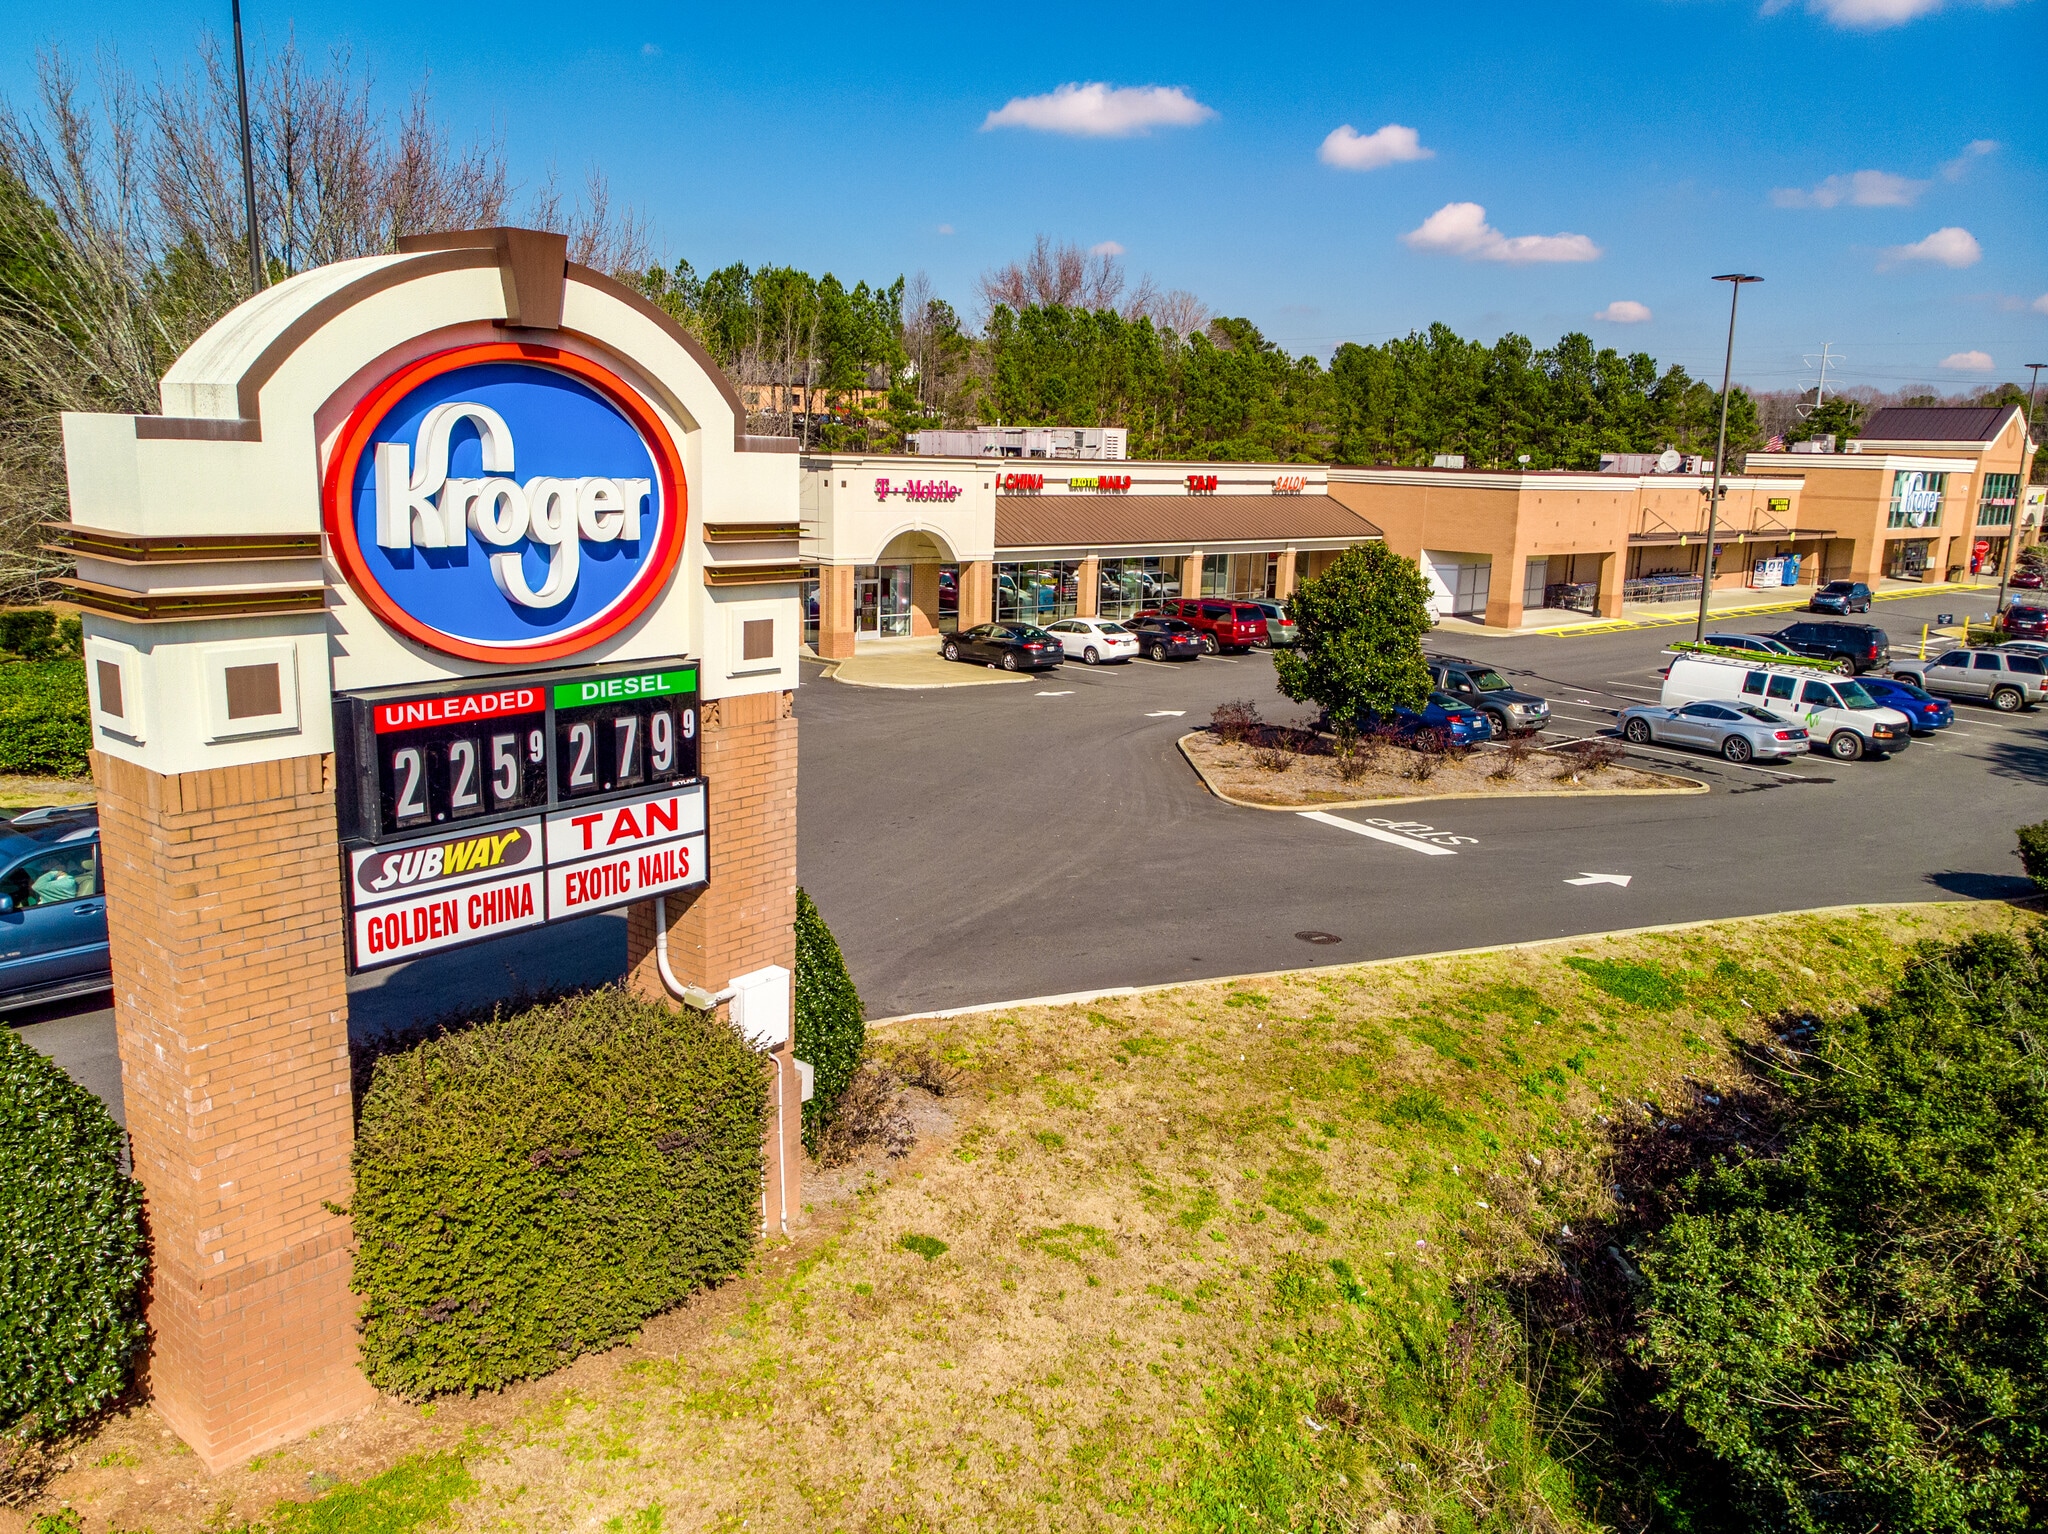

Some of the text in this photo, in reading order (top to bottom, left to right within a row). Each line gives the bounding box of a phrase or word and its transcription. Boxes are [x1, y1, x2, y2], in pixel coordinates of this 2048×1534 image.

[1005, 473, 1044, 490] CHINA
[1071, 475, 1132, 490] EXOTIC NAILS
[1187, 475, 1218, 491] TAN
[1274, 476, 1308, 491] SALON
[1898, 471, 1941, 527] Kroger
[375, 402, 651, 608] Kroger
[385, 689, 534, 726] UNLEADED
[582, 674, 671, 701] DIESEL
[571, 797, 679, 851] TAN
[370, 829, 521, 892] SUBWAY
[565, 846, 690, 907] EXOTIC NAILS
[367, 882, 534, 954] GOLDEN CHINA
